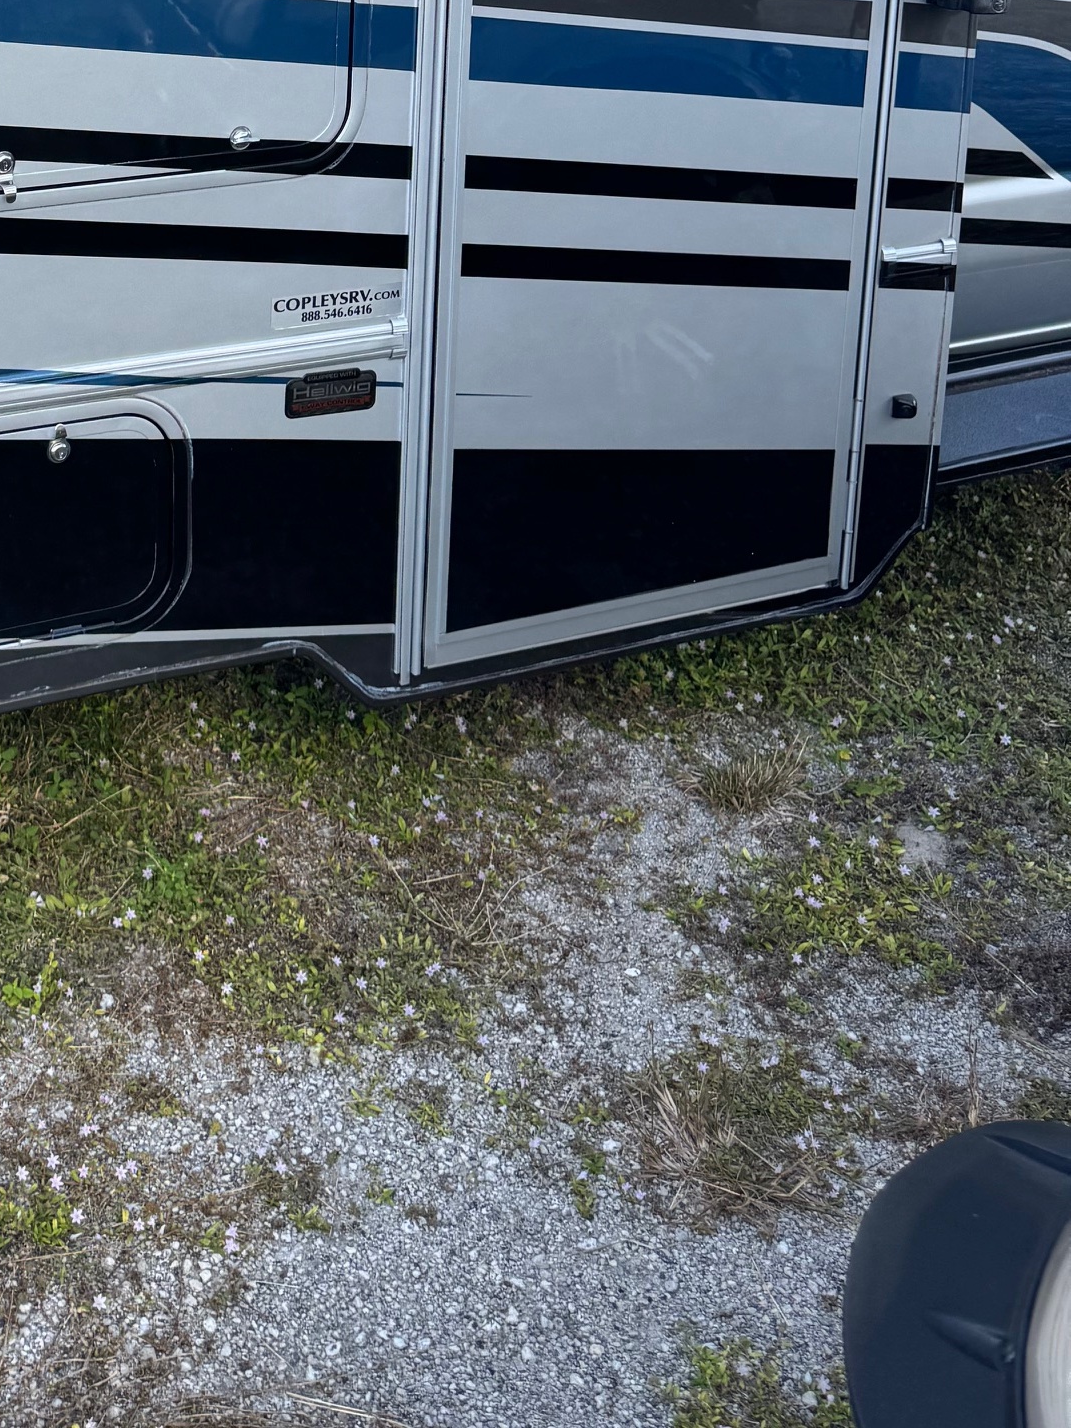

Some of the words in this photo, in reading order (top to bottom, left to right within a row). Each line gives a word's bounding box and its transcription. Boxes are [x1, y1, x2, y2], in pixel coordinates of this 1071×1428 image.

[273, 288, 401, 314] COPLEYSRV.COM
[301, 303, 373, 323] 888.546.6416
[307, 371, 339, 382] EQUIPPED
[339, 370, 357, 379] WITH
[293, 380, 371, 399] Hellwig
